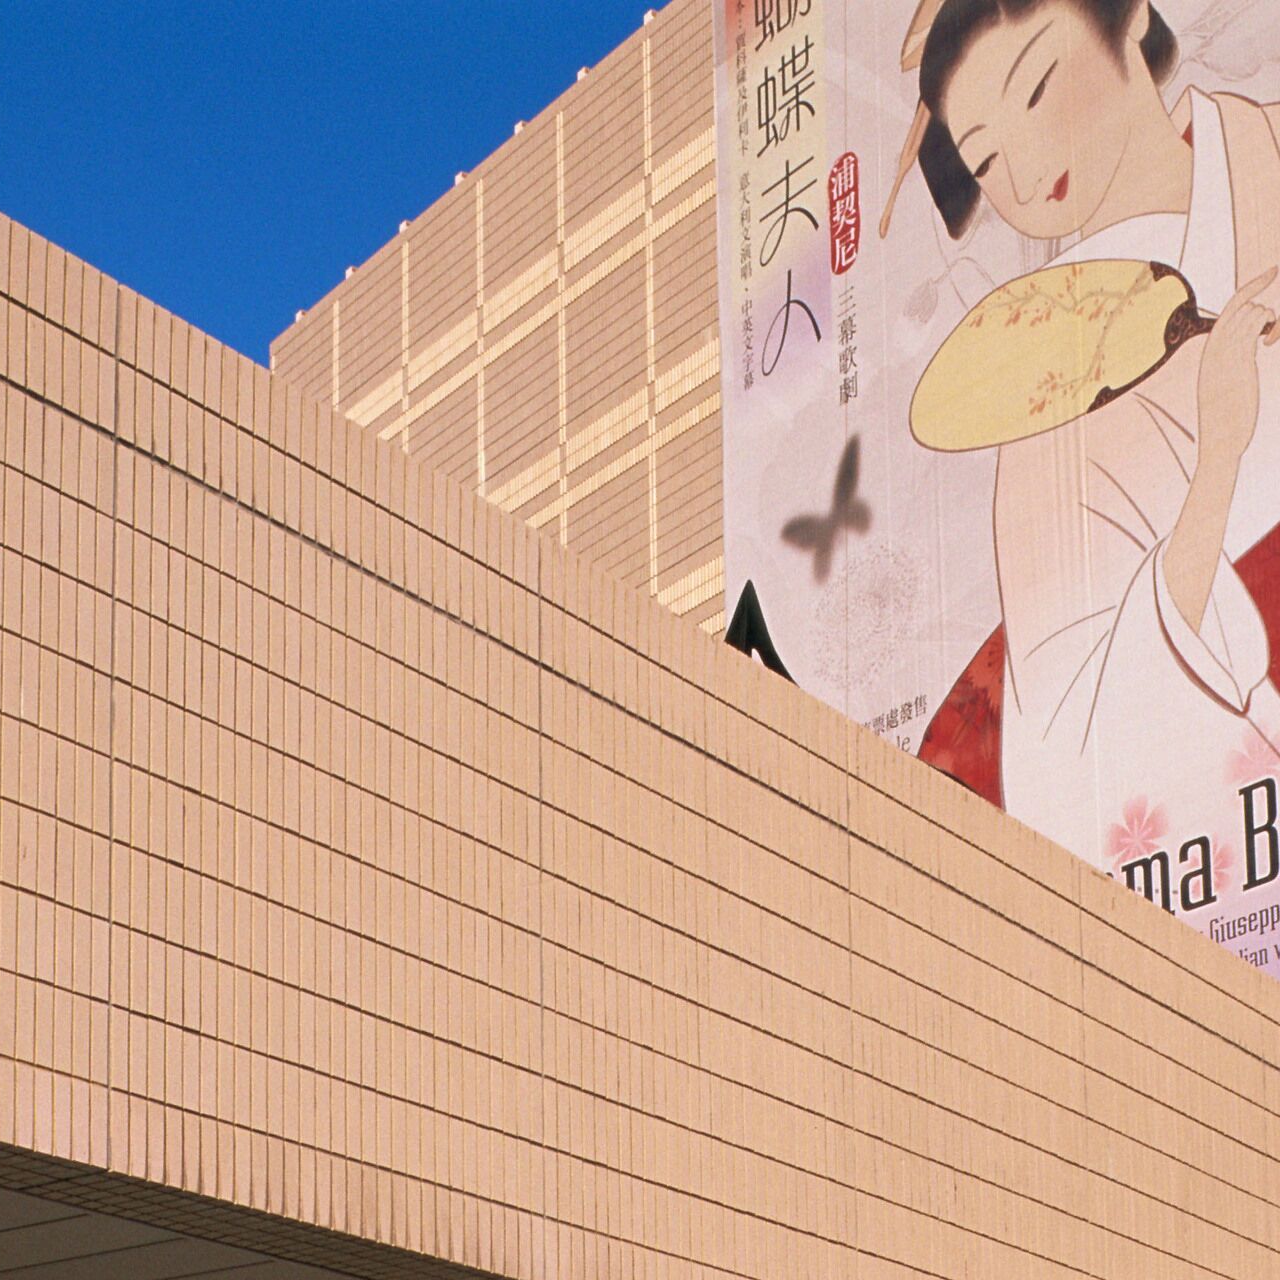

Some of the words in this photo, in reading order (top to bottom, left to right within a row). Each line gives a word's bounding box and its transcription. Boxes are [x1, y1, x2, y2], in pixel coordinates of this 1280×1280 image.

[831, 155, 857, 273] 浦契尼
[838, 286, 858, 406] 三幕歌劇
